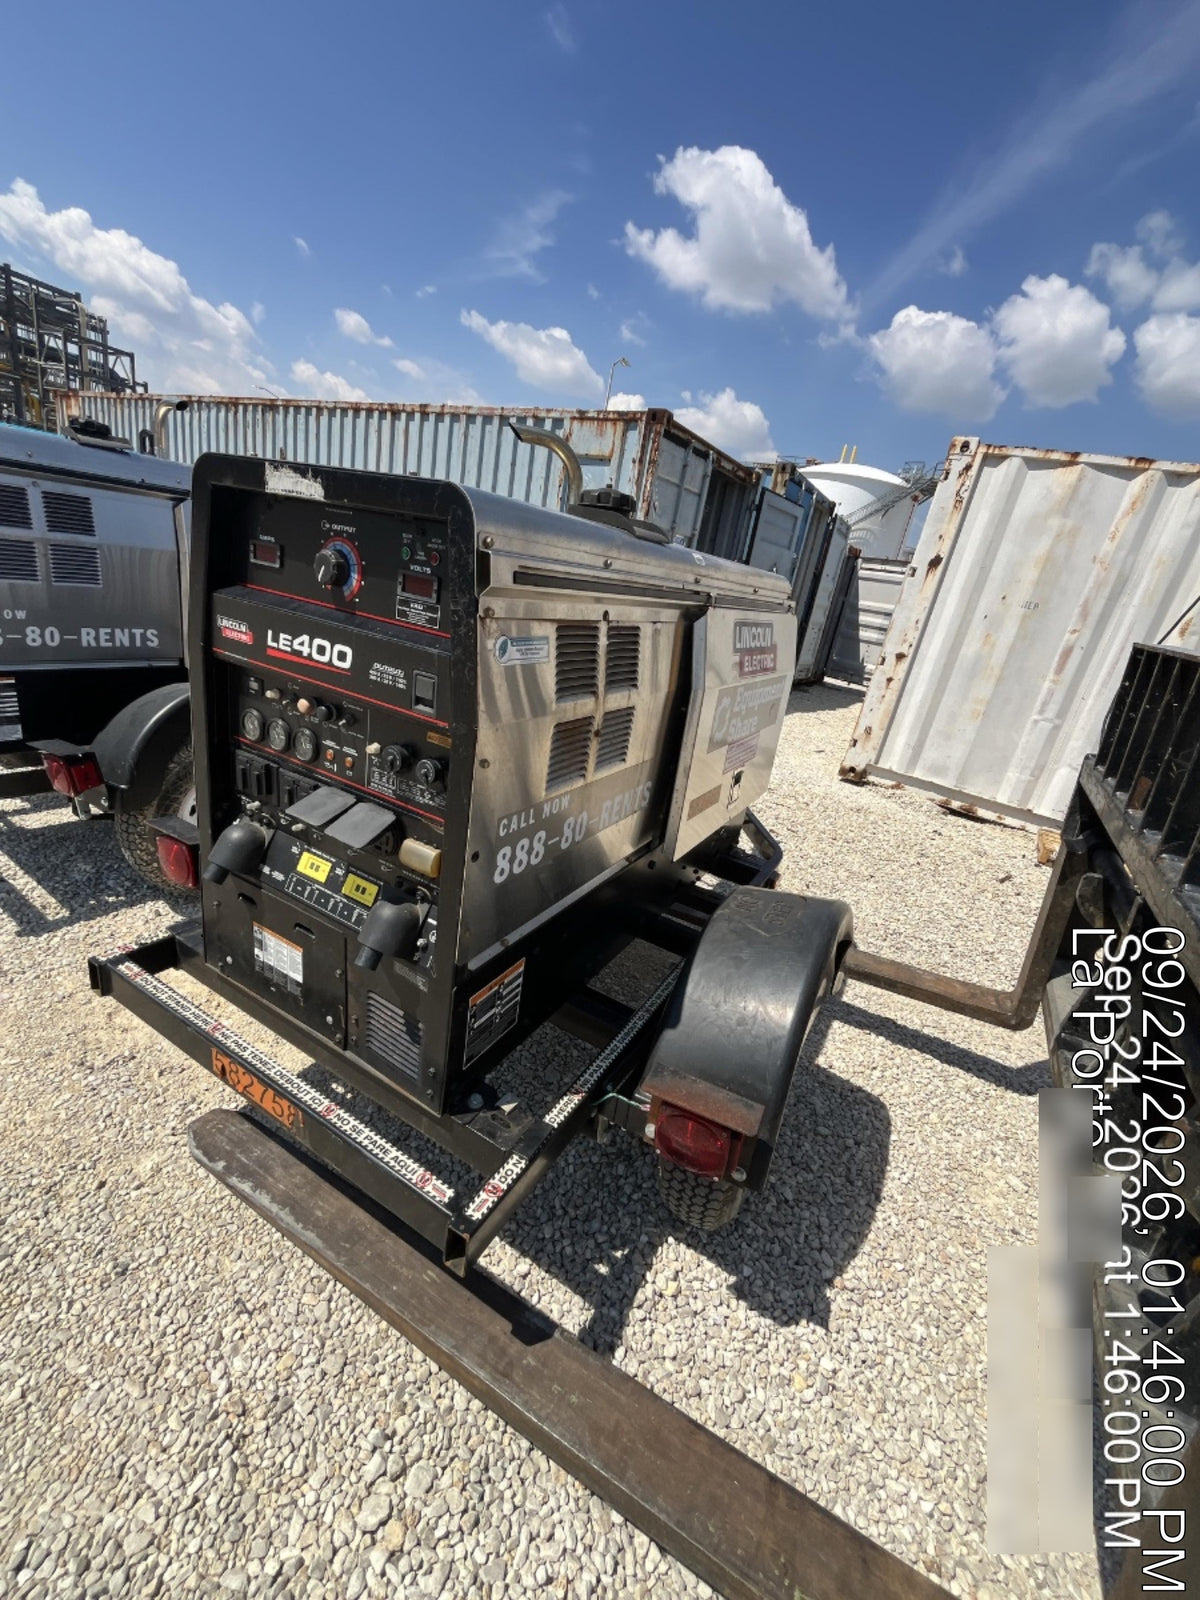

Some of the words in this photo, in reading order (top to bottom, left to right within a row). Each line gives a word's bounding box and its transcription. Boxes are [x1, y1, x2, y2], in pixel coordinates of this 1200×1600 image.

[409, 564, 432, 574] VOLTS
[0, 625, 160, 648] -80-RENTS
[218, 616, 247, 632] LINCOLN
[735, 625, 772, 649] LINCOLN
[267, 629, 353, 669] LE400
[743, 653, 774, 673] ELECTRIC
[732, 680, 785, 715] Equipment
[728, 715, 758, 741] Share
[500, 808, 536, 837] CALL
[542, 795, 571, 819] NOW
[493, 781, 652, 884] 888-80-RENTS
[140, 977, 153, 986] DO
[152, 984, 168, 995] NOT
[165, 995, 192, 1012] STAND
[189, 1011, 213, 1026] HERE
[219, 1031, 233, 1040] NE
[231, 1039, 249, 1053] PAS
[249, 1051, 276, 1071] TENEZ
[274, 1069, 312, 1097] DEBOUT
[309, 1094, 324, 1106] ICI
[333, 1113, 350, 1126] NO
[349, 1124, 365, 1137] SE
[362, 1134, 392, 1157] PARE
[498, 1168, 514, 1185] DO
[556, 1096, 576, 1119] HERE
